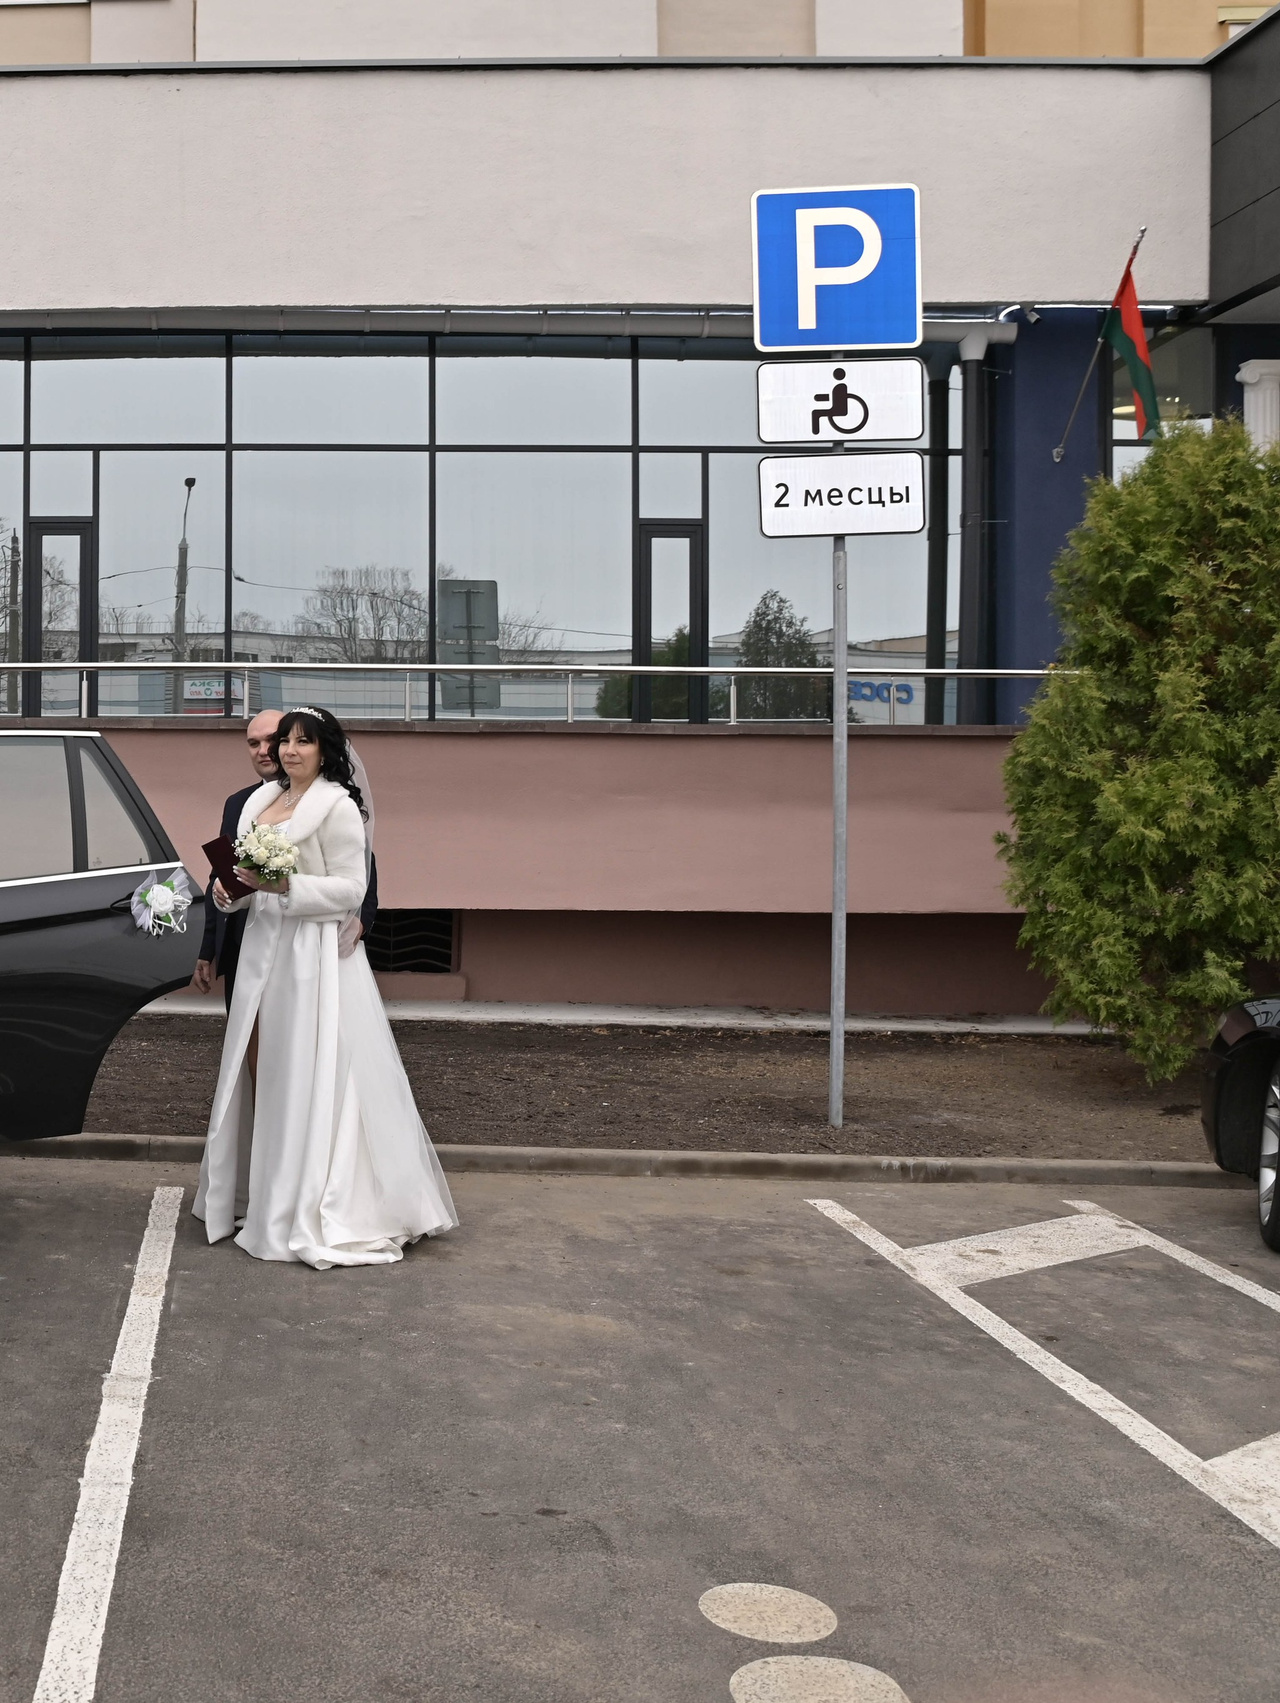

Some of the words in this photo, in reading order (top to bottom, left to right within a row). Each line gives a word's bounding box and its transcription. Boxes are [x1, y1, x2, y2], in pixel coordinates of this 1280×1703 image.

[795, 206, 883, 330] P
[774, 483, 790, 508] 2
[803, 485, 910, 508] месцы
